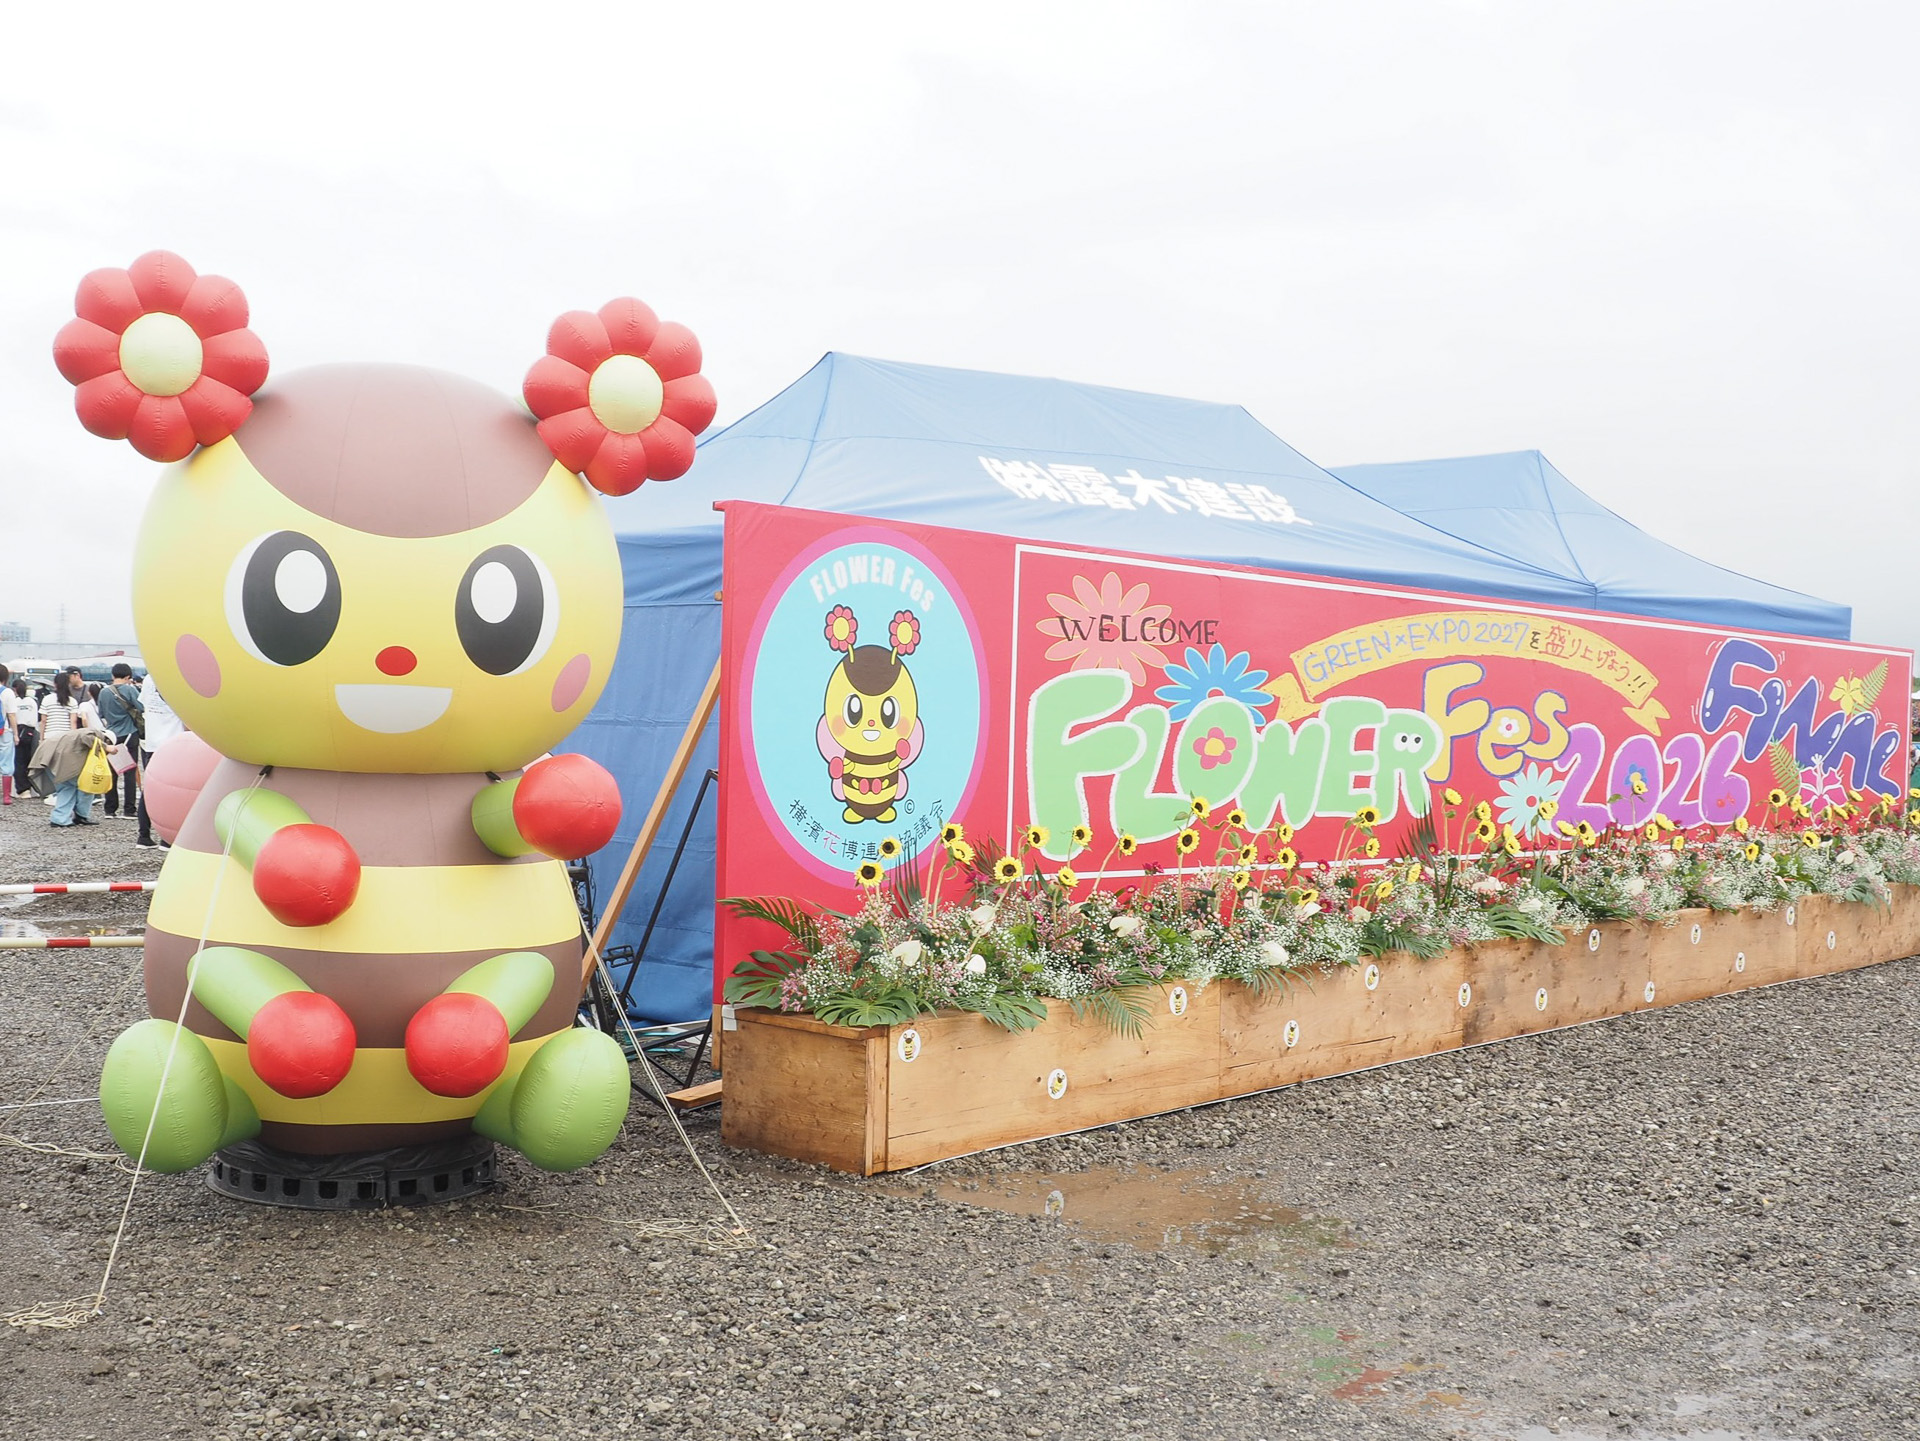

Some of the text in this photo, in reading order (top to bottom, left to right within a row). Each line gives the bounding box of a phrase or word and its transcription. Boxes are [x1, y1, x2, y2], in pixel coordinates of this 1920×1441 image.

[809, 554, 935, 612] FLOWER Fes
[1055, 614, 1220, 646] WELCOME
[1027, 660, 1571, 861] FLOWER Fes
[1549, 722, 1751, 839] 2026
[788, 799, 944, 861] 横濱花博連協議会
